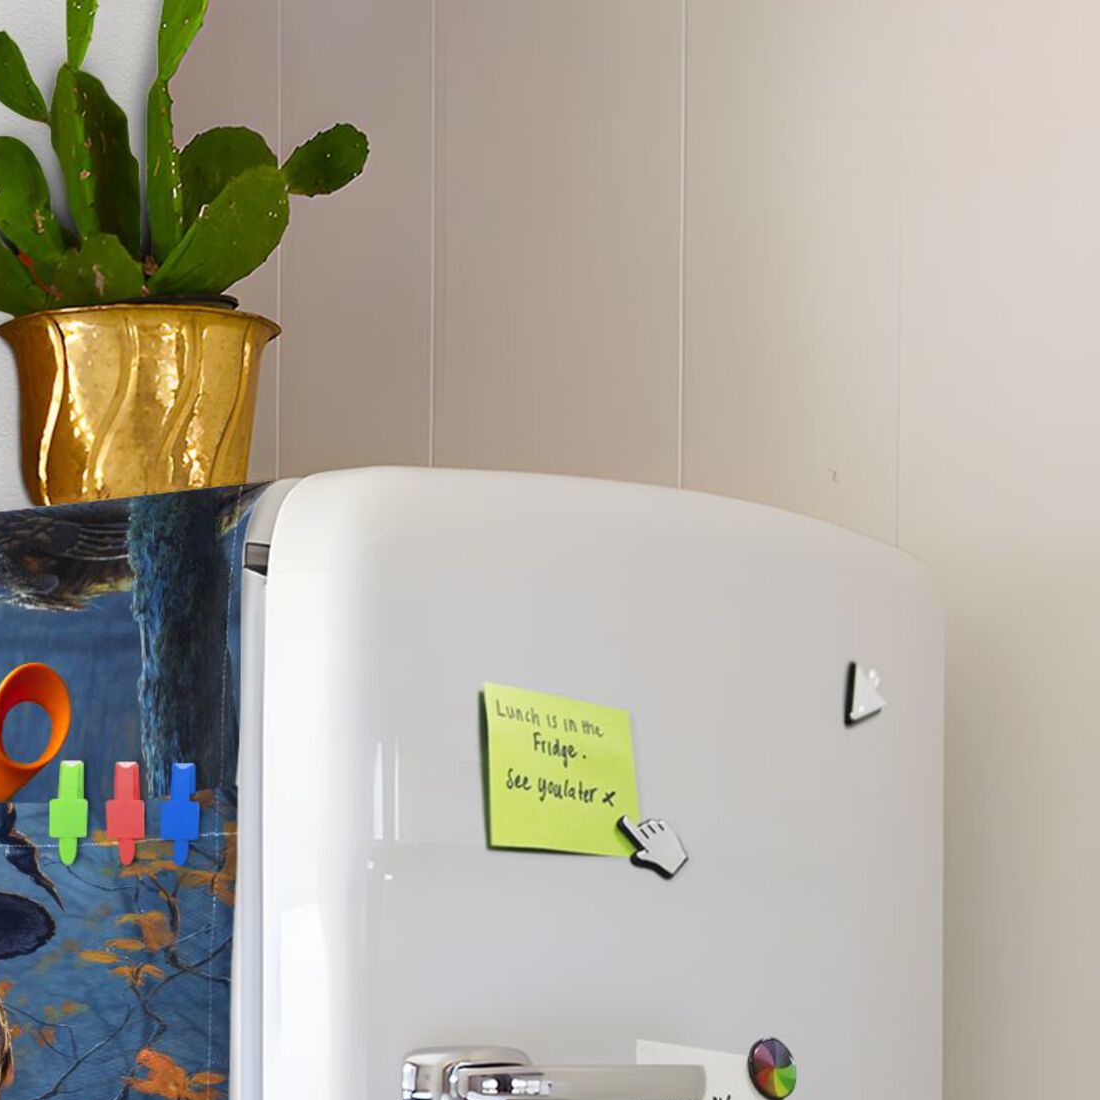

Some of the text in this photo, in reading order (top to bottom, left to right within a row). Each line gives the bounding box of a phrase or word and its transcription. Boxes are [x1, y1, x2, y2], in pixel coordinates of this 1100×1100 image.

[495, 699, 540, 726] Lunch
[563, 718, 578, 733] in
[581, 720, 604, 738] the
[506, 768, 532, 790] See
